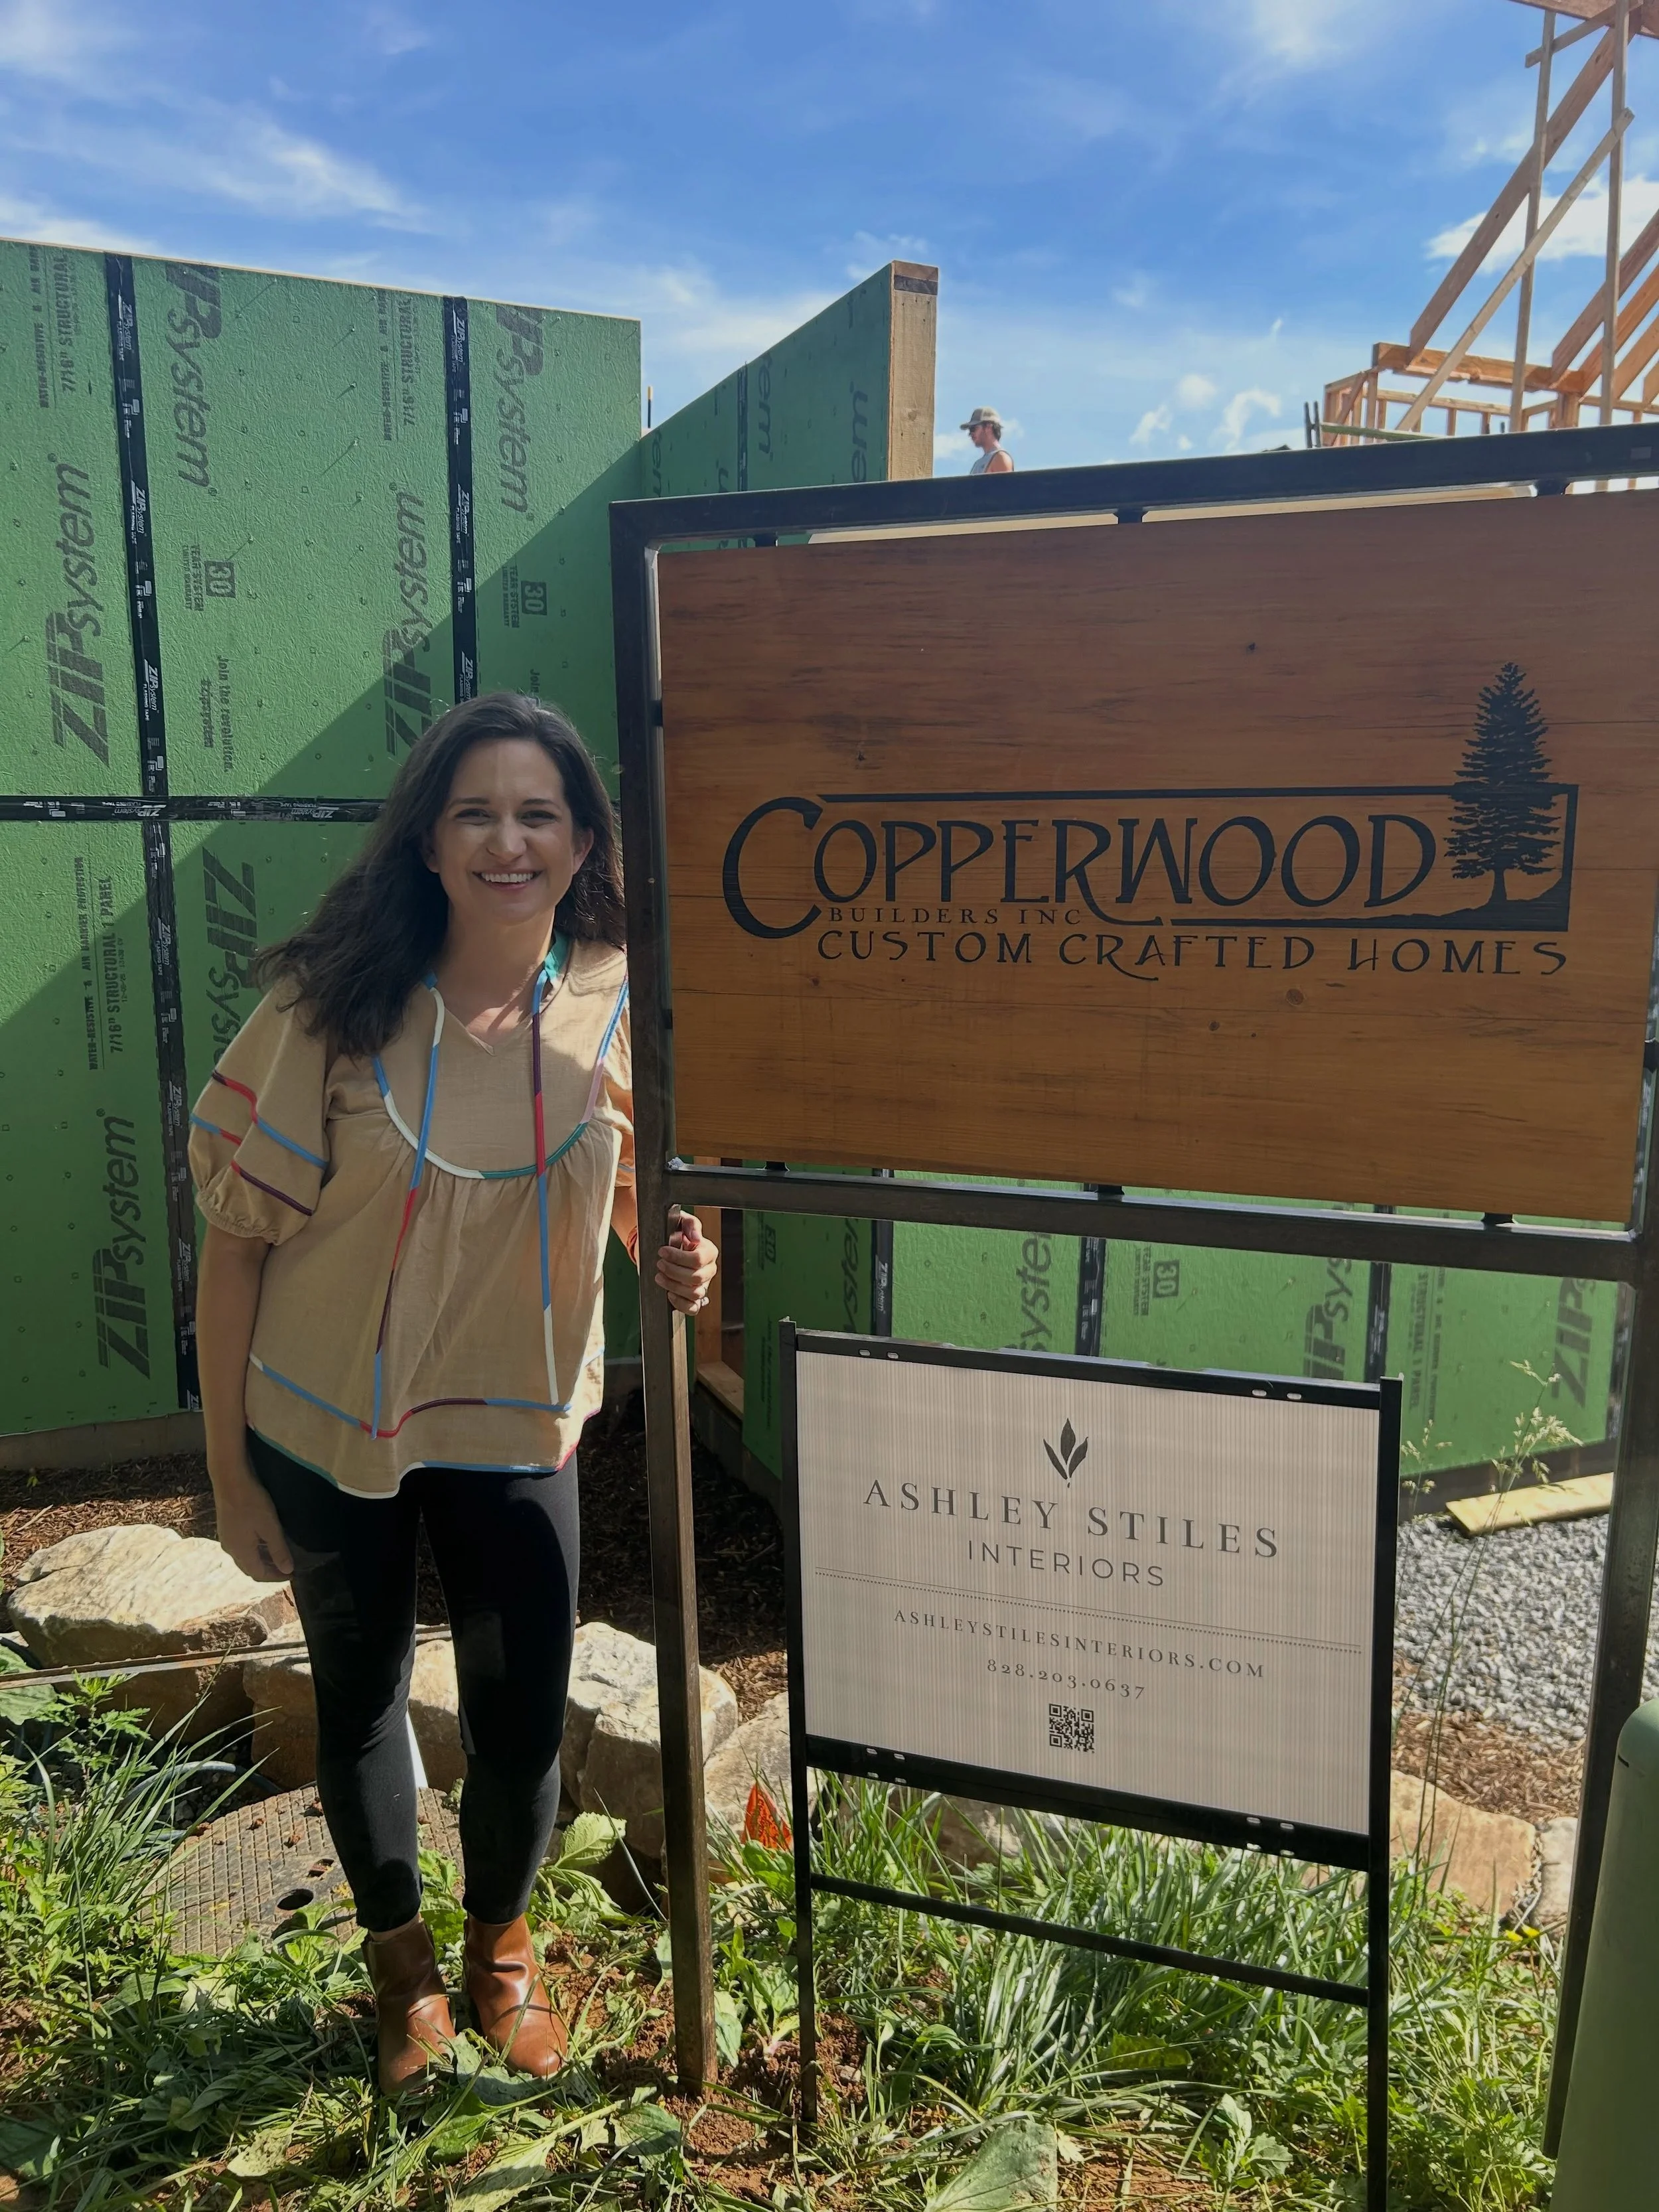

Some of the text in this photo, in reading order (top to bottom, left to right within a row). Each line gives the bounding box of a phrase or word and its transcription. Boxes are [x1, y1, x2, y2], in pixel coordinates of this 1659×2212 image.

[53, 254, 73, 346] STRUCTURAL
[208, 565, 233, 595] 30
[524, 585, 543, 613] 30
[217, 654, 229, 682] Join
[220, 686, 232, 705] the
[722, 796, 1436, 939] COPPERWOOD
[98, 875, 113, 917] PANEL
[78, 914, 90, 952] BARRIER
[828, 907, 1081, 925] BUILDERS INC
[82, 956, 92, 971] AIR
[102, 933, 119, 1013] STRUCTURAL
[818, 930, 1568, 981] CUSTOM CRAFTED HOMES
[108, 1017, 123, 1053] 7/16"
[1156, 1265, 1177, 1295] 30
[863, 1479, 1279, 1558] ASHLEY STILES
[968, 1540, 1164, 1587] INTERIORS
[894, 1609, 1264, 1678] ASHLEYSTILESINTERIORS.COM
[987, 1659, 1146, 1700] 828.203.0637
